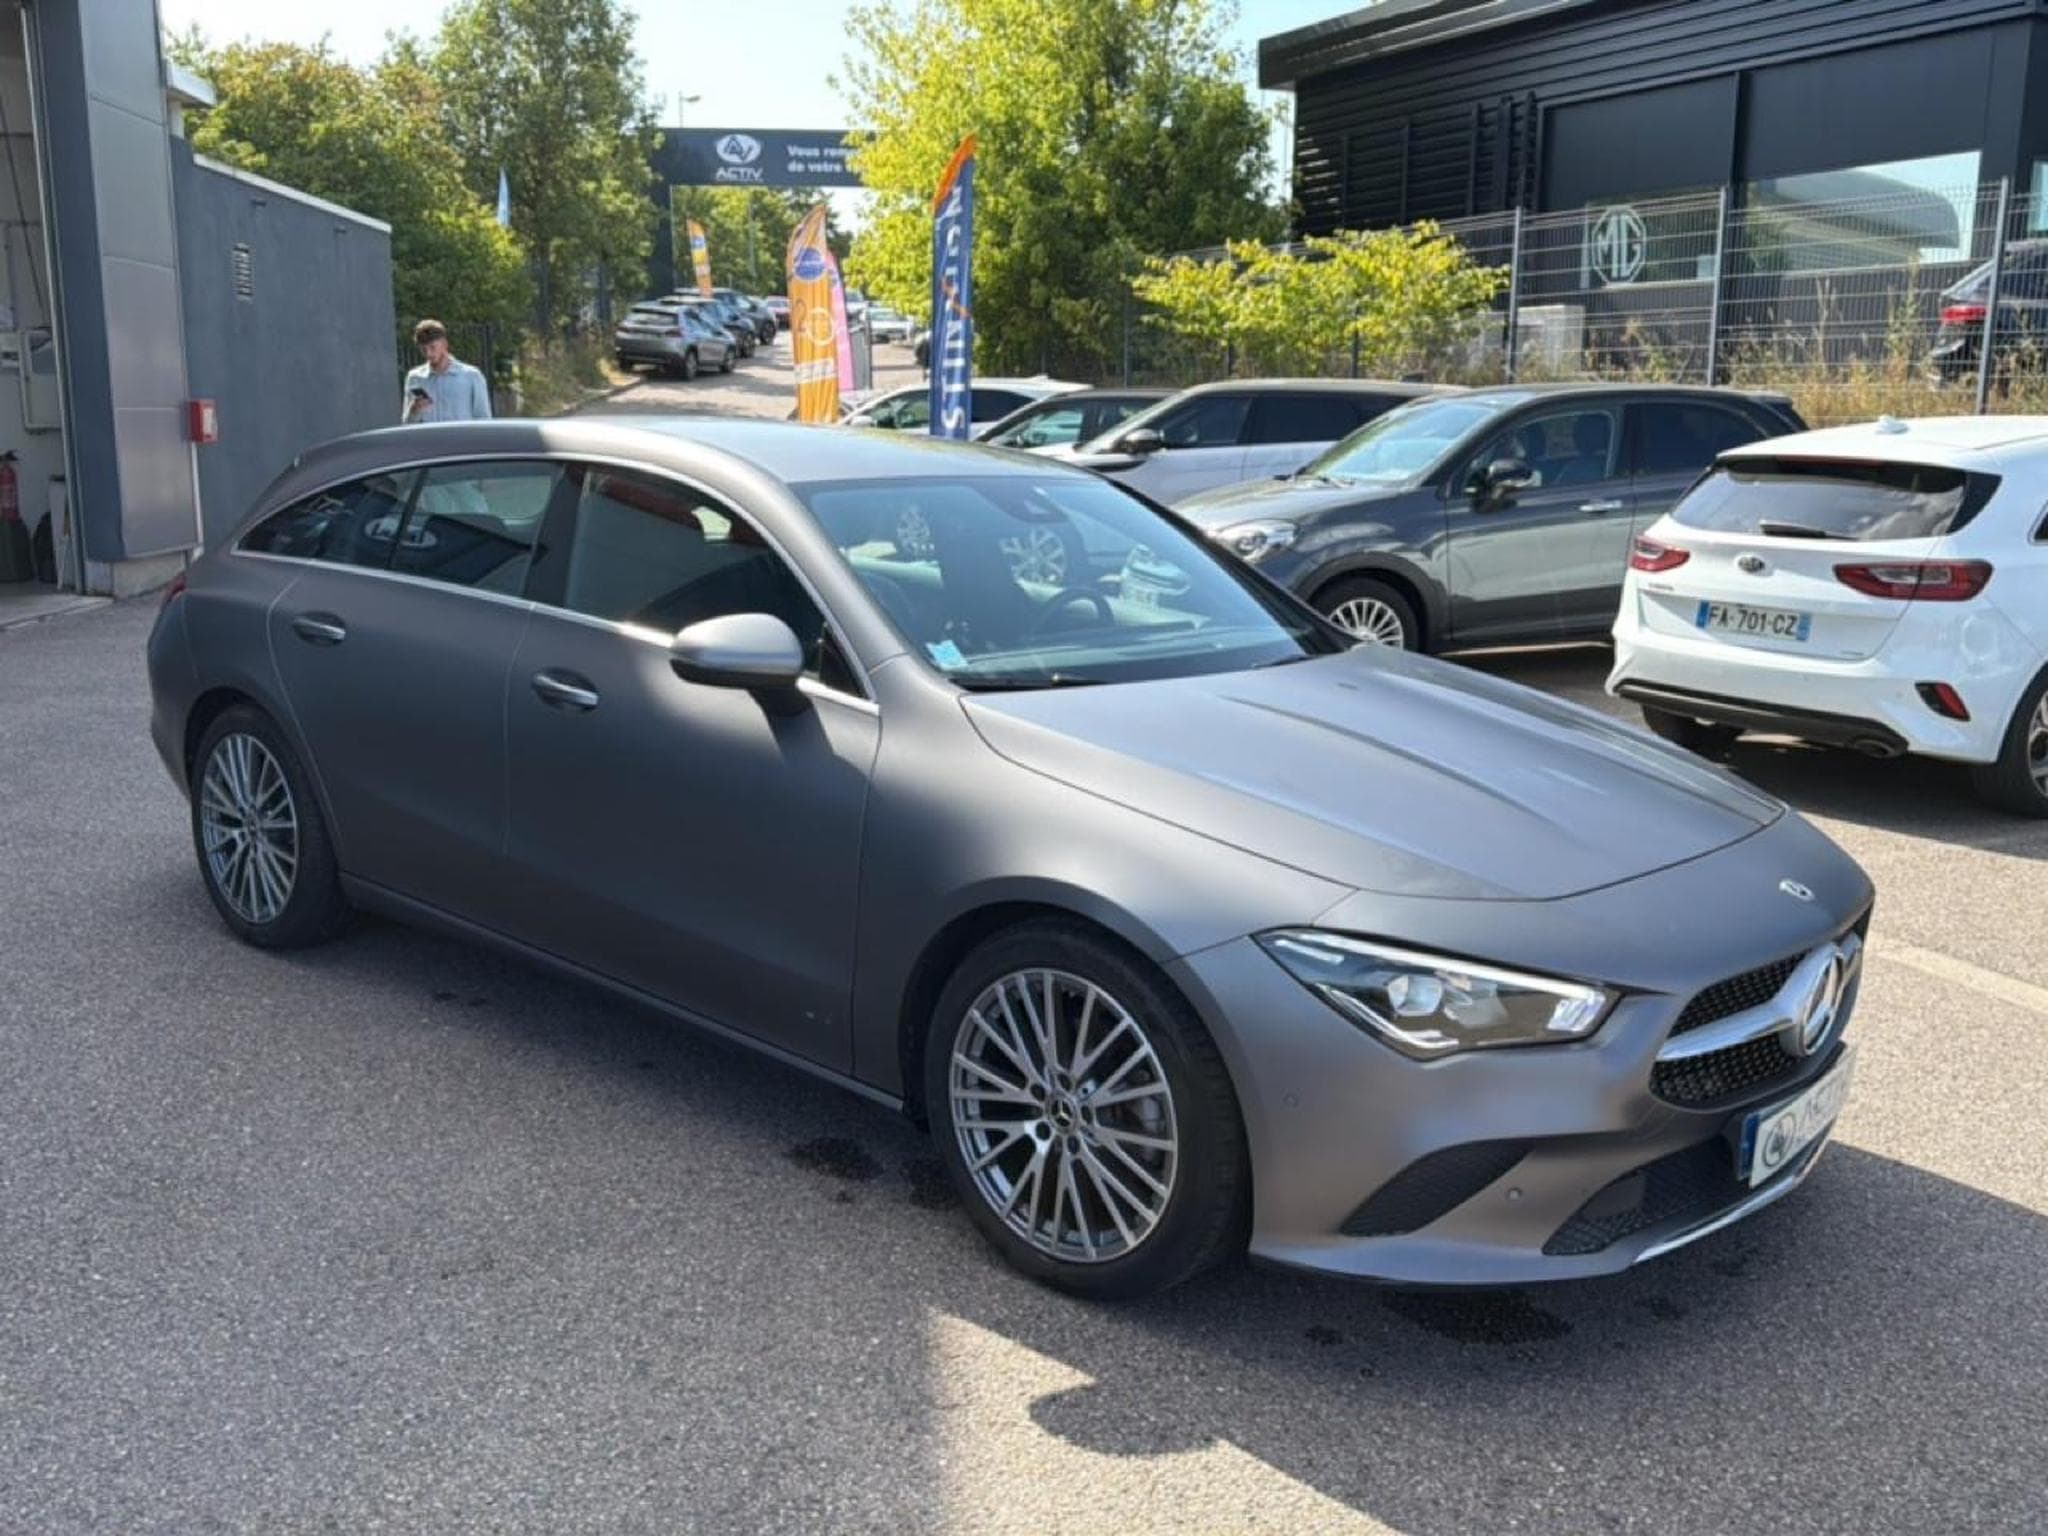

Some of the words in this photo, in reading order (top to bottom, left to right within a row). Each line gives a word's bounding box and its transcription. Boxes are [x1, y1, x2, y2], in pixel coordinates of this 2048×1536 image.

[786, 145, 820, 157] Vous
[787, 160, 805, 172] de
[808, 160, 842, 172] votre
[716, 166, 763, 182] ACTIV
[1597, 213, 1642, 279] MG
